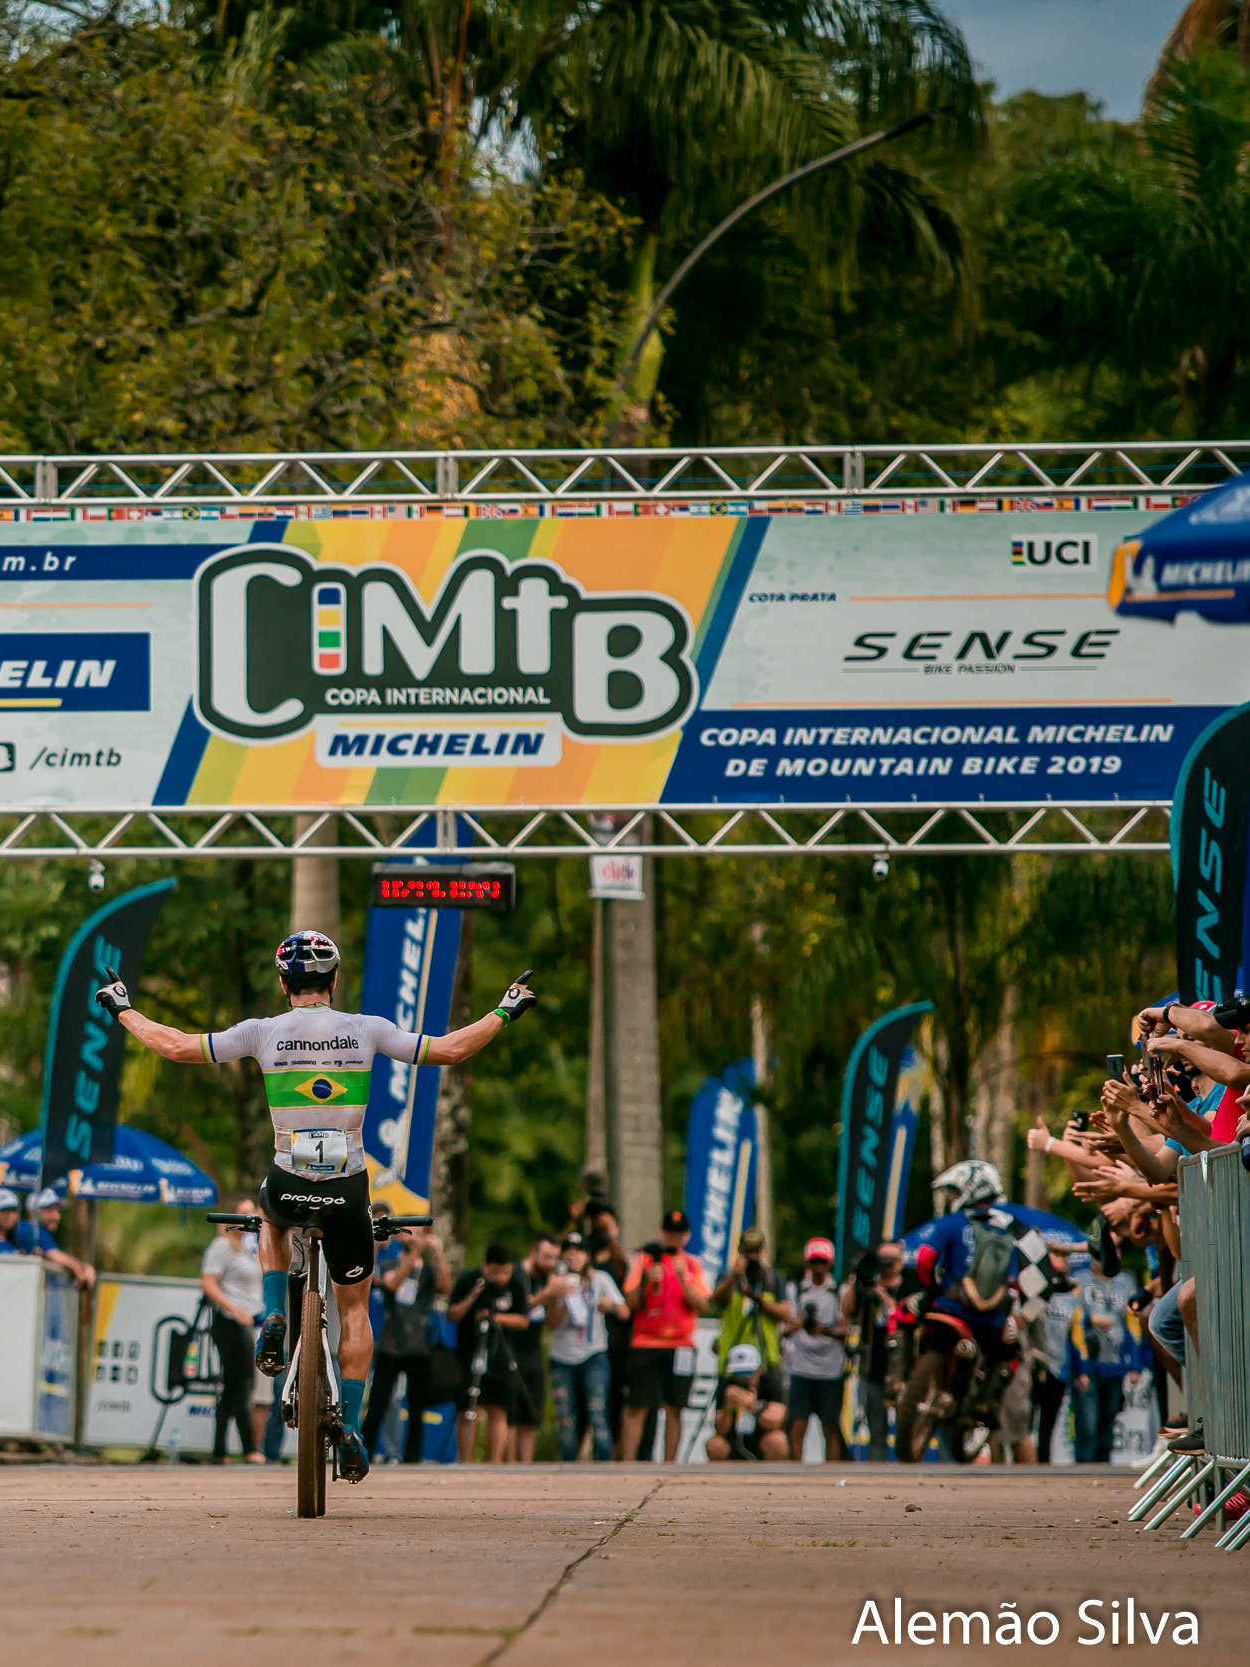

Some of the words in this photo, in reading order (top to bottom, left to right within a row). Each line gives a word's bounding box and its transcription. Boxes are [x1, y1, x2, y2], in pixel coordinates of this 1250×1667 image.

[1027, 540, 1091, 566] UCI
[749, 592, 786, 602] COTA
[789, 592, 837, 602] PRATA
[842, 629, 1121, 662] SENSE
[924, 664, 953, 675] BIKE
[957, 664, 1016, 674] PASSION
[325, 688, 382, 706] COPA
[385, 687, 551, 706] INTERNACIONAL
[327, 732, 546, 757] MICHELIN
[700, 728, 777, 747] COPA
[783, 726, 1021, 747] INTERNACIONAL
[1026, 724, 1175, 744] MICHELIN
[29, 747, 123, 770] /cimtb
[725, 758, 767, 777] DE
[775, 757, 953, 777] MOUNTAIN
[961, 757, 1040, 776] BIKE
[1047, 756, 1123, 775] 2019
[1196, 767, 1227, 1005] ENSE
[276, 1035, 359, 1051] cannondale
[315, 1141, 324, 1163] 1
[852, 1045, 889, 1250] SENSE
[280, 1193, 346, 1205] prologo
